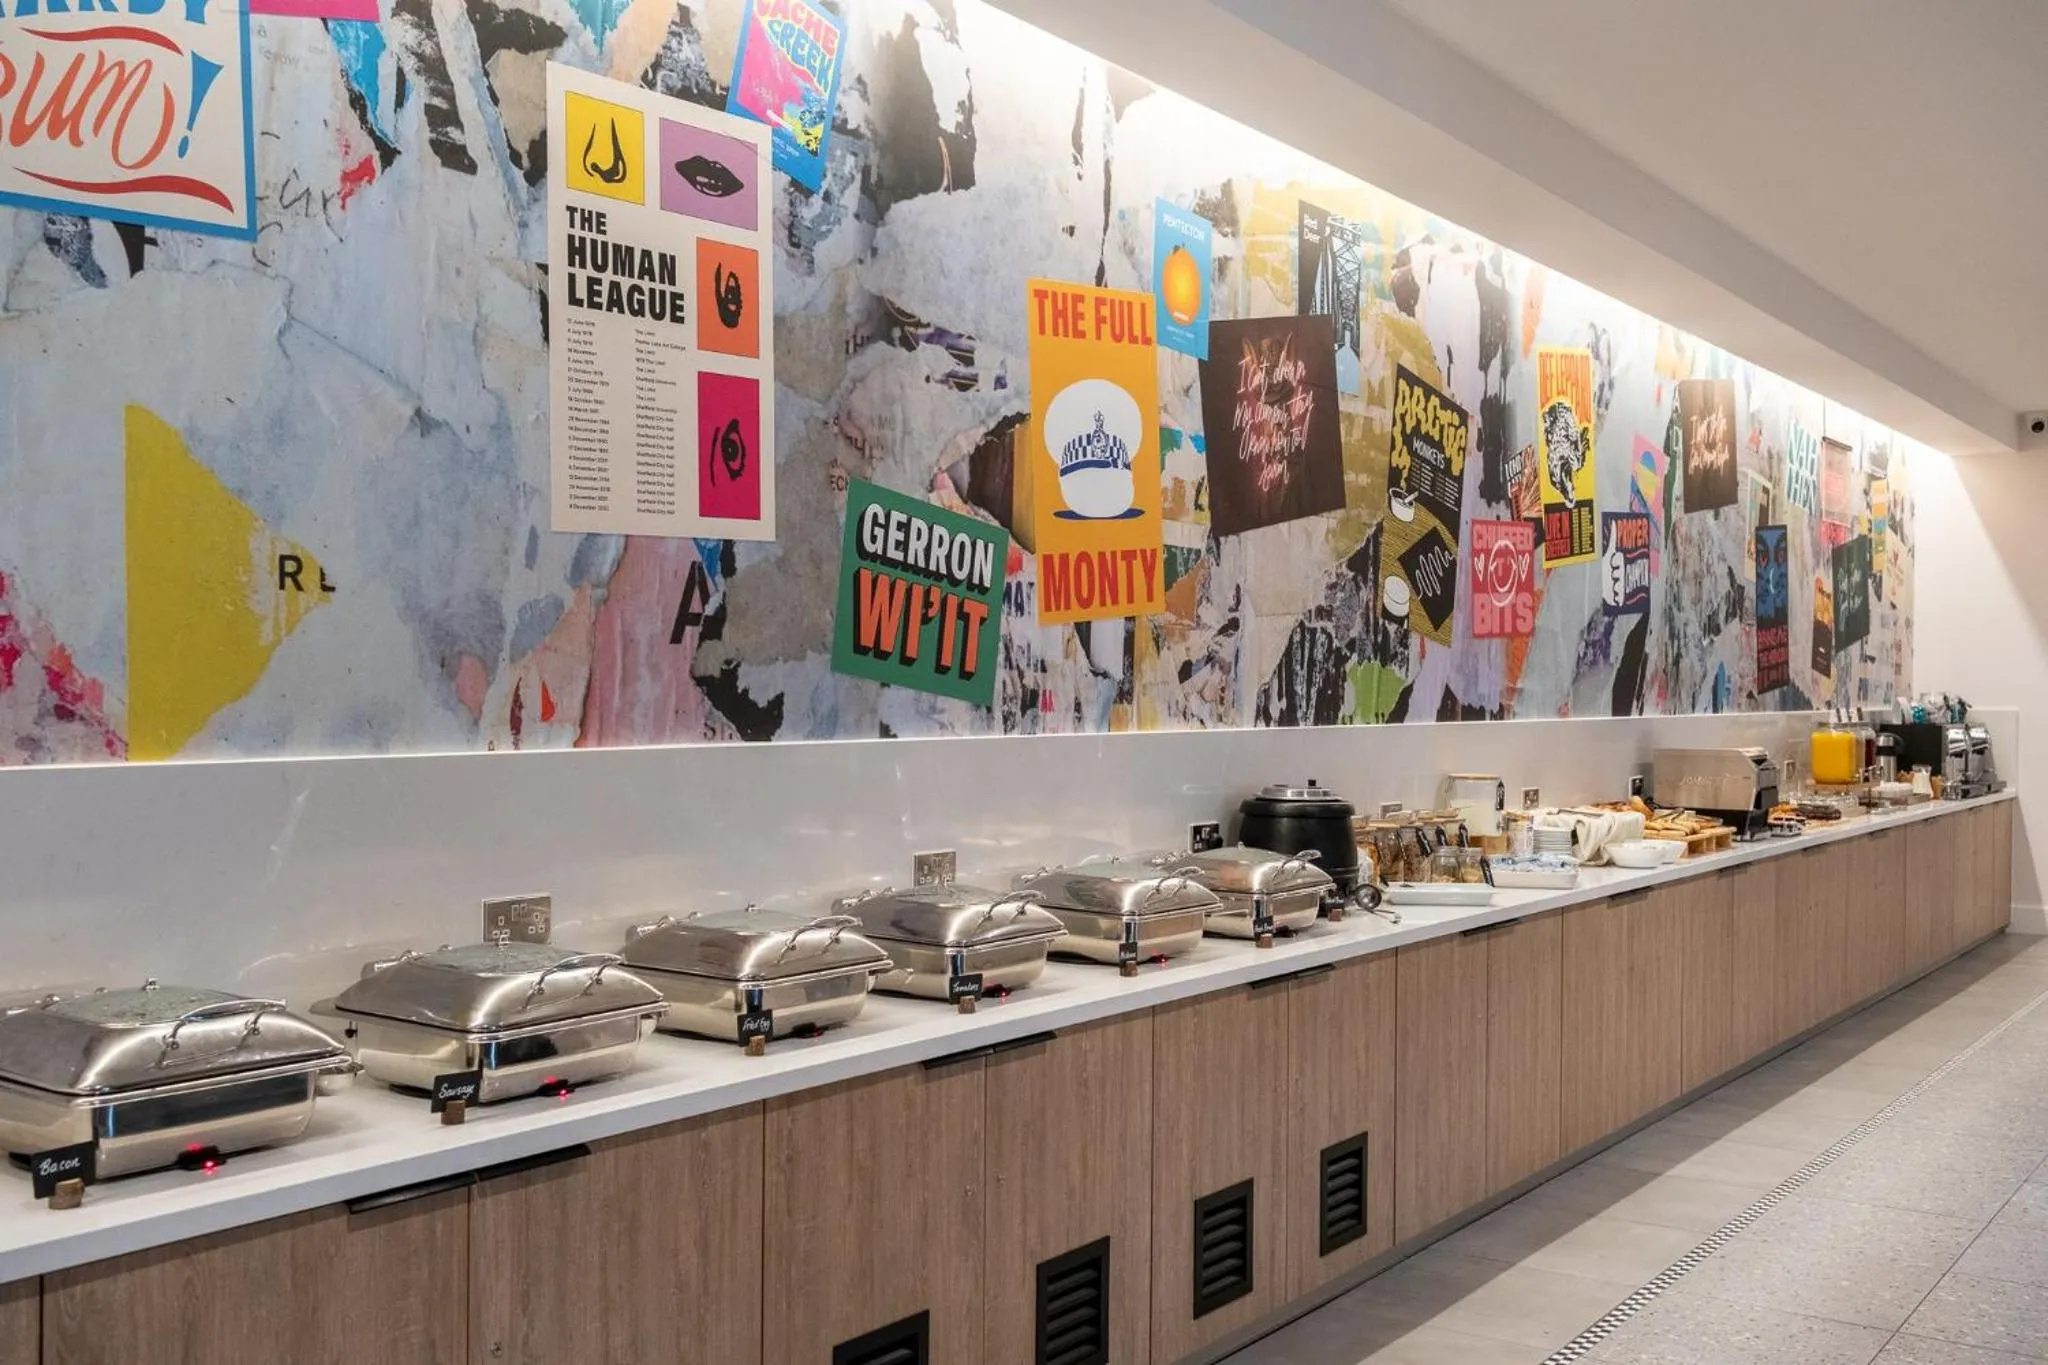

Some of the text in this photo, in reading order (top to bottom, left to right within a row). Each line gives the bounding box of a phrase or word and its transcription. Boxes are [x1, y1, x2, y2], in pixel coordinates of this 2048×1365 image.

[566, 205, 607, 235] THE
[567, 233, 677, 287] HUMAN
[567, 272, 686, 325] LEAGUE
[1033, 288, 1153, 347] THE FULL
[862, 503, 994, 588] GERRON
[1473, 524, 1533, 551] CHUFFED
[1043, 548, 1158, 613] MONTY
[1474, 592, 1533, 634] BITS
[40, 1157, 81, 1176] Bacon
